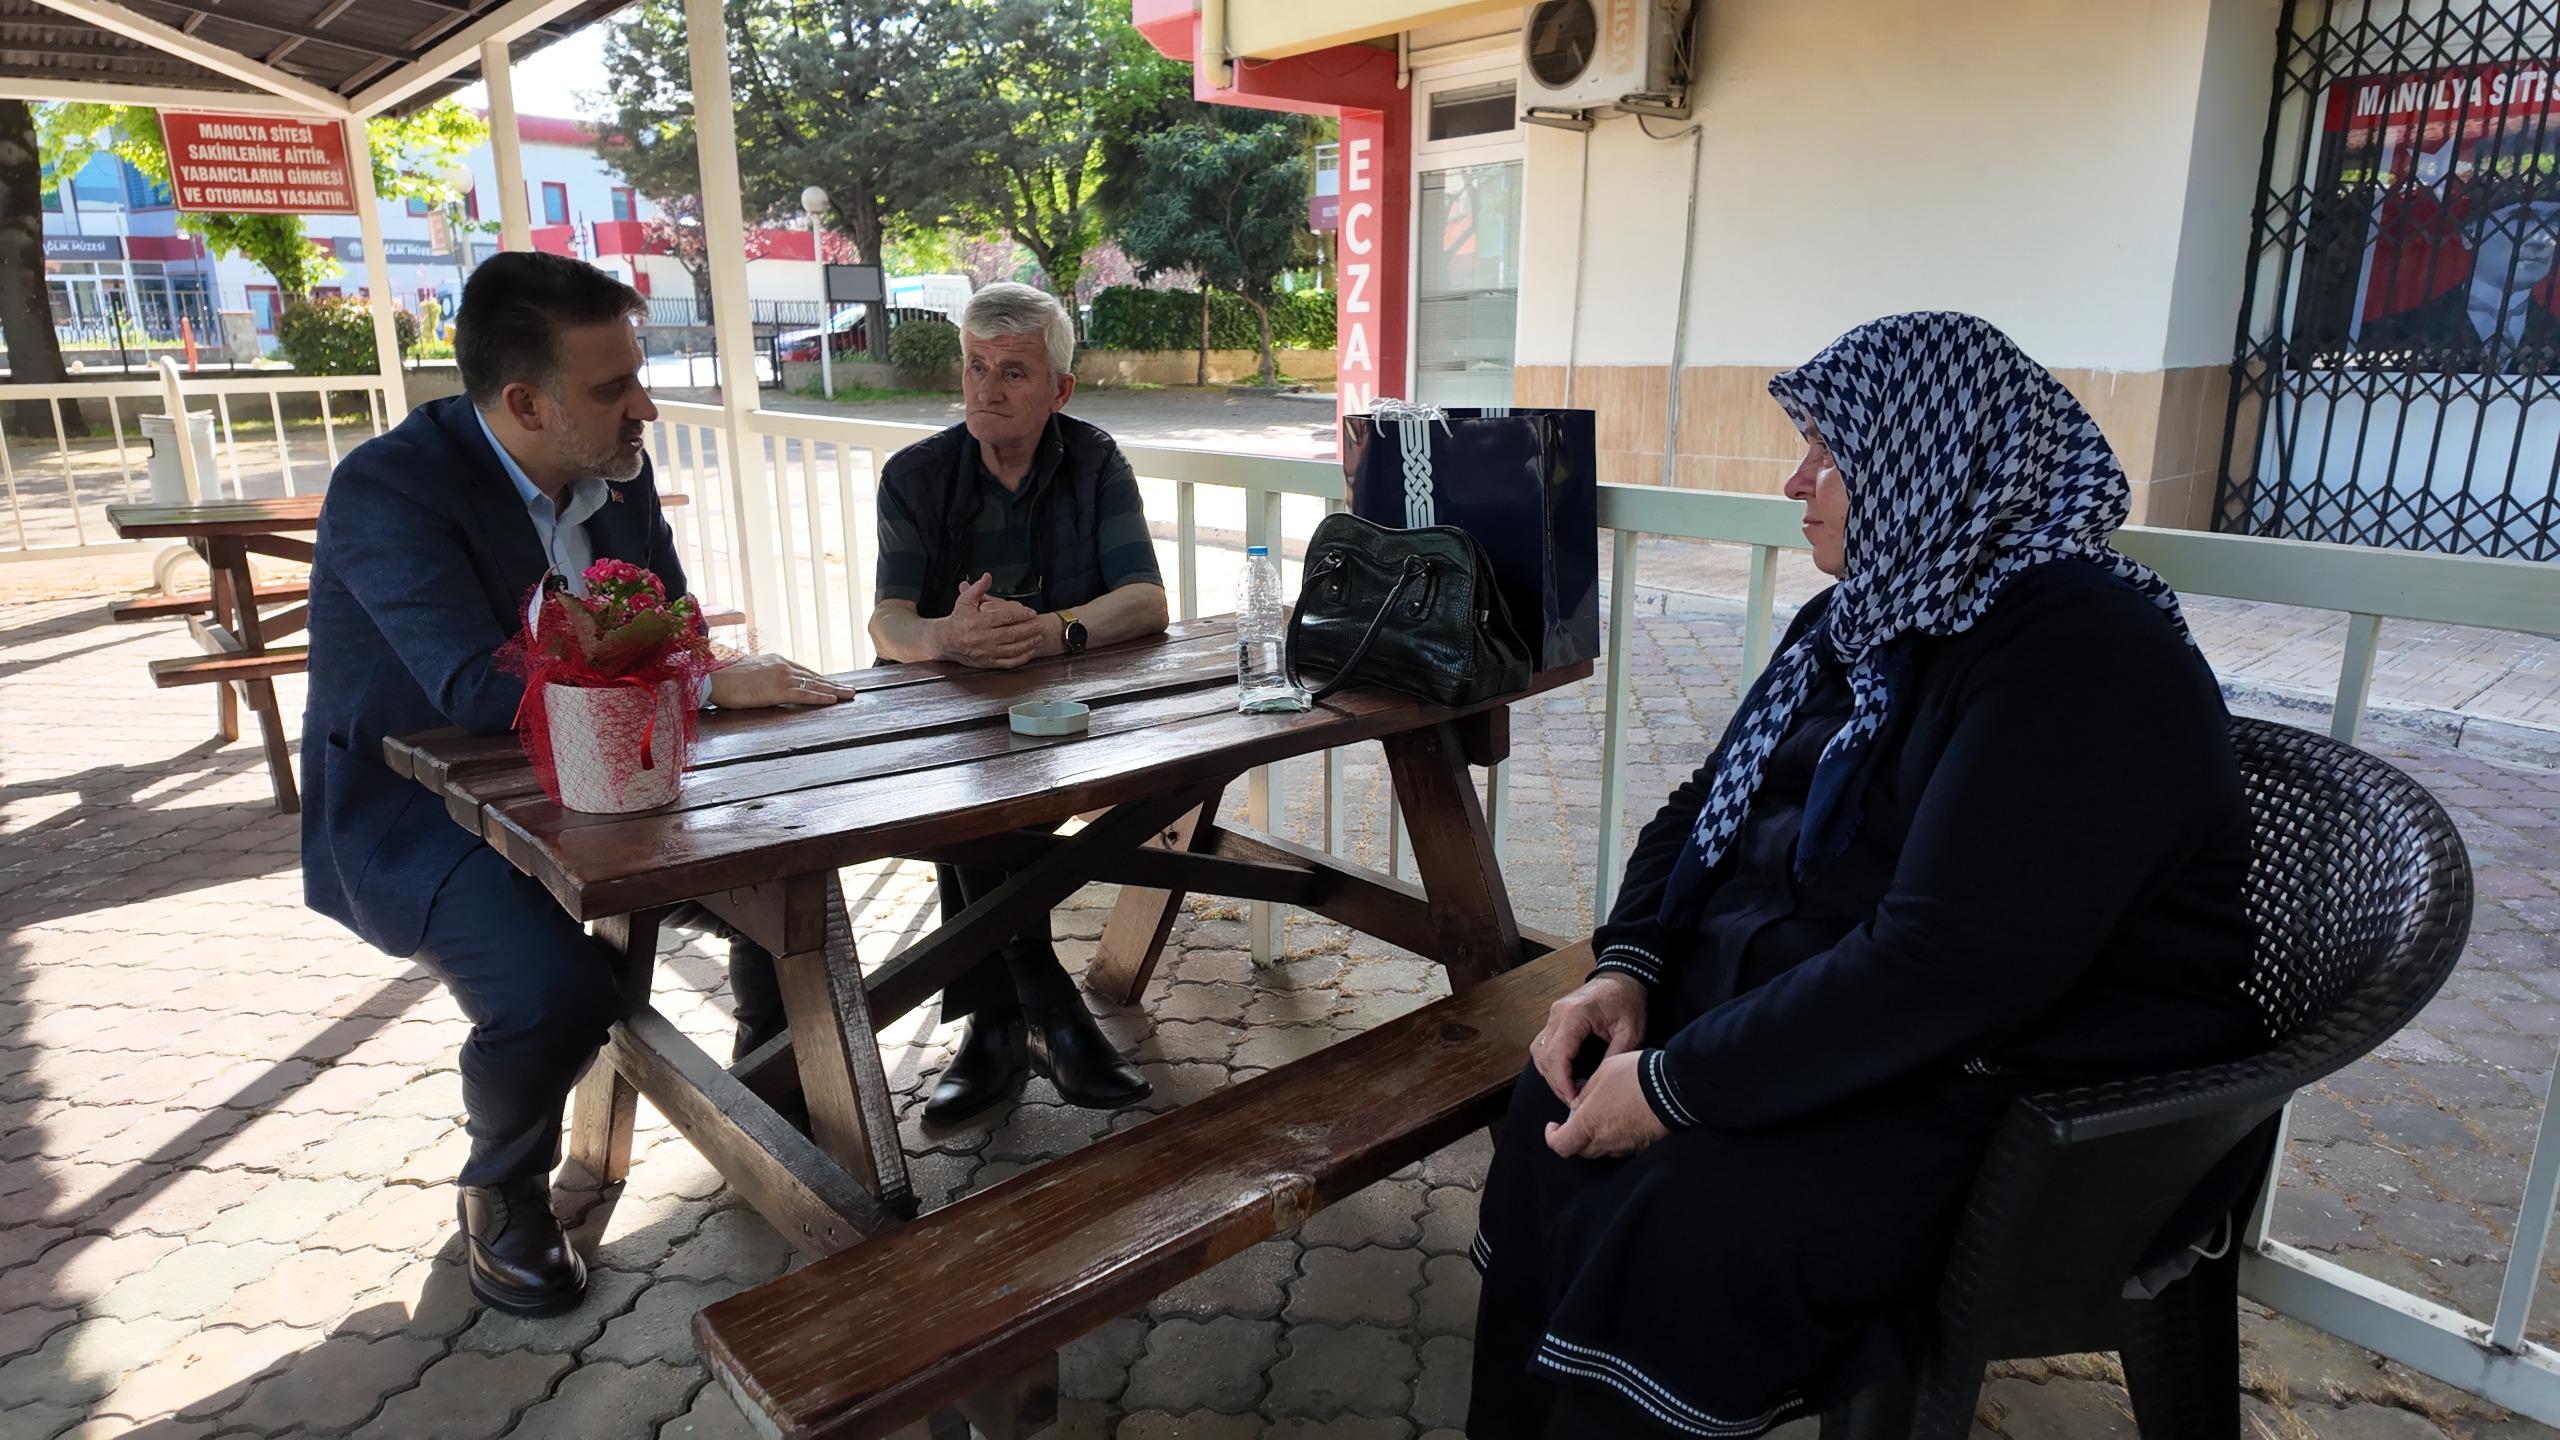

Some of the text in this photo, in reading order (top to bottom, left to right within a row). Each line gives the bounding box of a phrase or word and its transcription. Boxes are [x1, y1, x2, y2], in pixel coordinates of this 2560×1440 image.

[2357, 76, 2482, 116] MANOLYA
[199, 123, 313, 143] MANOLYA SİTESİ
[188, 142, 330, 165] SAKİNLERİNE AİTTİR.
[180, 166, 344, 186] YABANCILARIN GİRMESİ
[183, 187, 349, 206] VE OTURMASI YASAKTIR.
